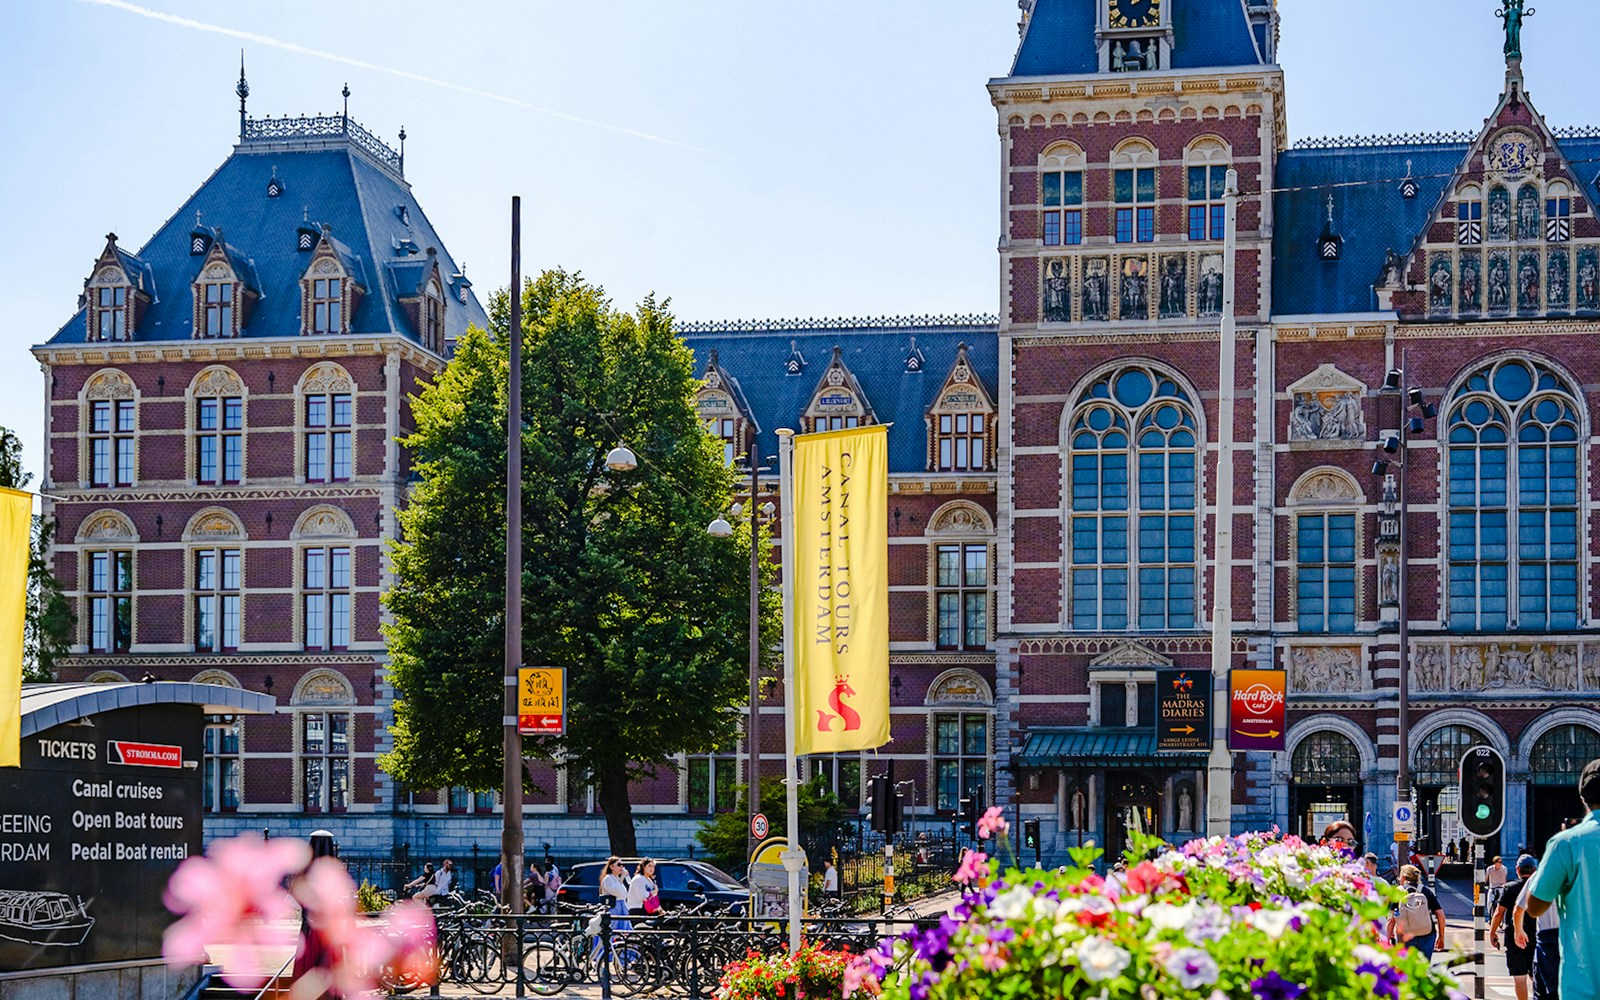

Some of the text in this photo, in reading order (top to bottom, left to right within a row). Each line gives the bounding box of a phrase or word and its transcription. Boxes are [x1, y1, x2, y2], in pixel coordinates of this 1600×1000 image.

[816, 465, 832, 645] AMSTERDAM
[836, 452, 852, 655] CANAL TOURS
[1162, 700, 1205, 708] MADRAS
[1233, 689, 1283, 704] Hard Rock
[1162, 709, 1205, 717] DIARIES
[38, 739, 96, 760] TICKETS
[126, 748, 178, 761] STROMMA.COM
[72, 778, 163, 800] Canal cruises
[0, 814, 52, 833] EEING
[72, 810, 184, 831] Open Boat tours
[756, 821, 765, 831] 30
[72, 842, 188, 861] Pedal Boat rental
